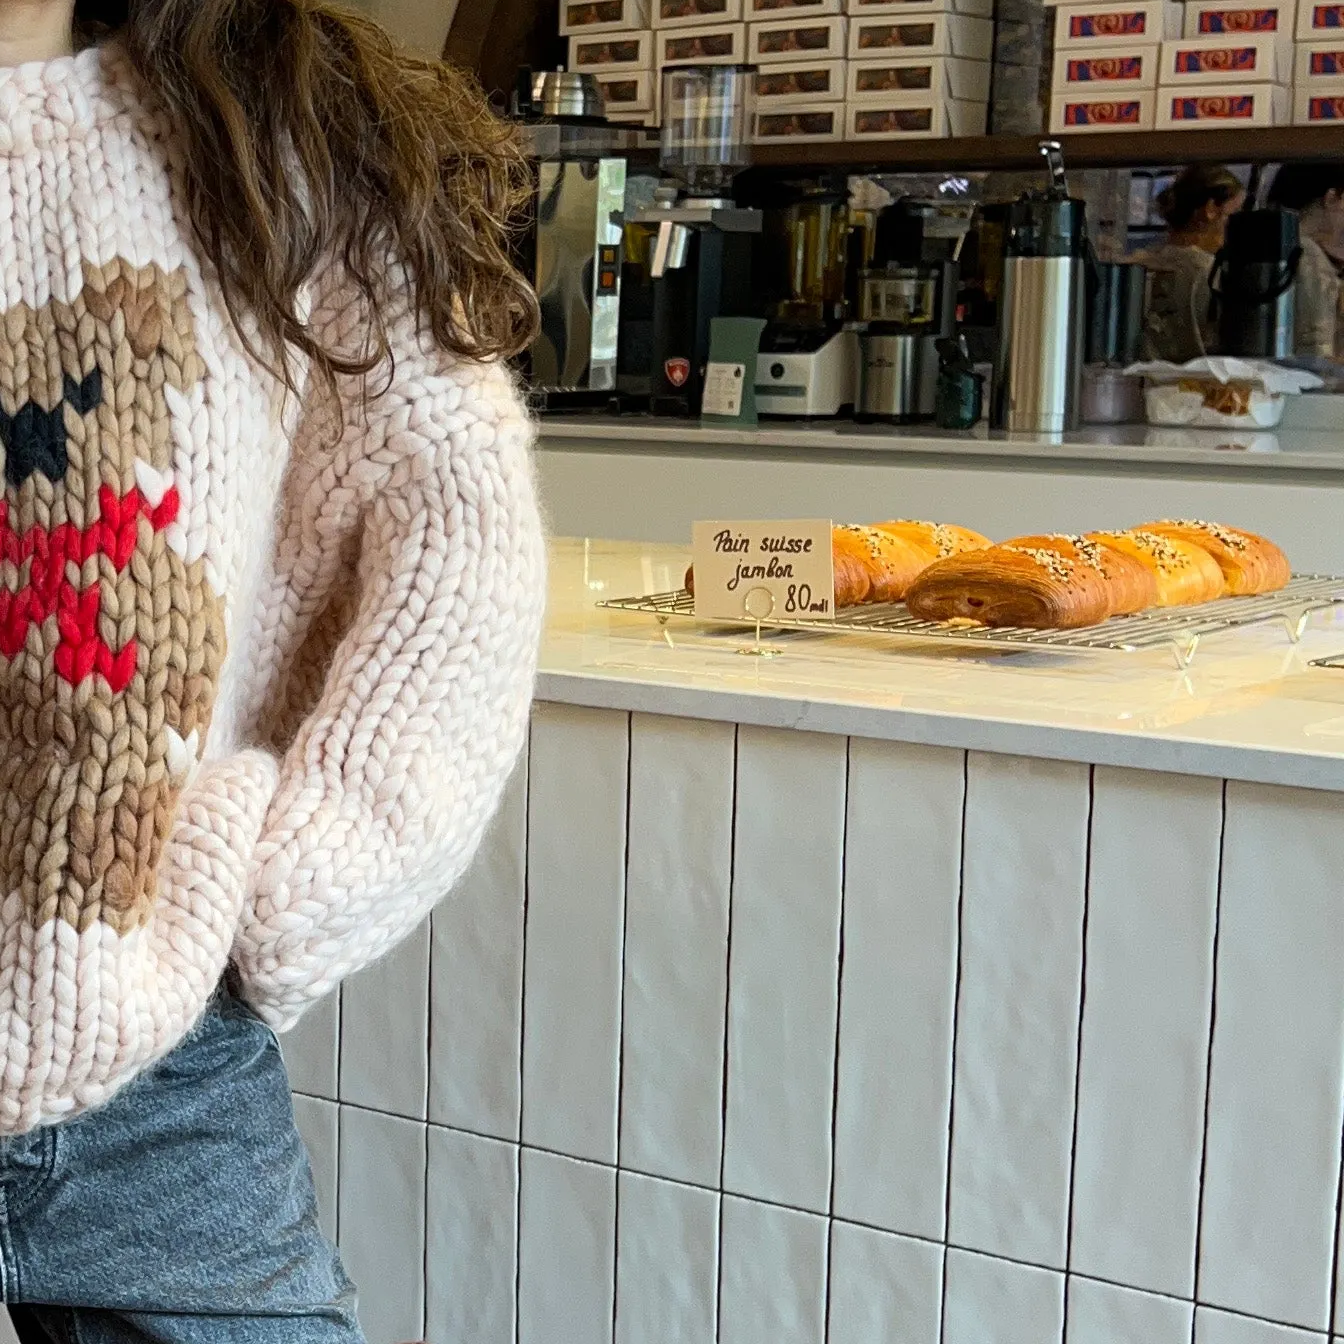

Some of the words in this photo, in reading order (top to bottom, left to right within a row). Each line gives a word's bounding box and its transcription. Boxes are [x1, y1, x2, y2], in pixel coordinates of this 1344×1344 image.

[713, 529, 750, 554] Pain
[760, 536, 813, 553] suisse
[727, 557, 795, 591] jambon
